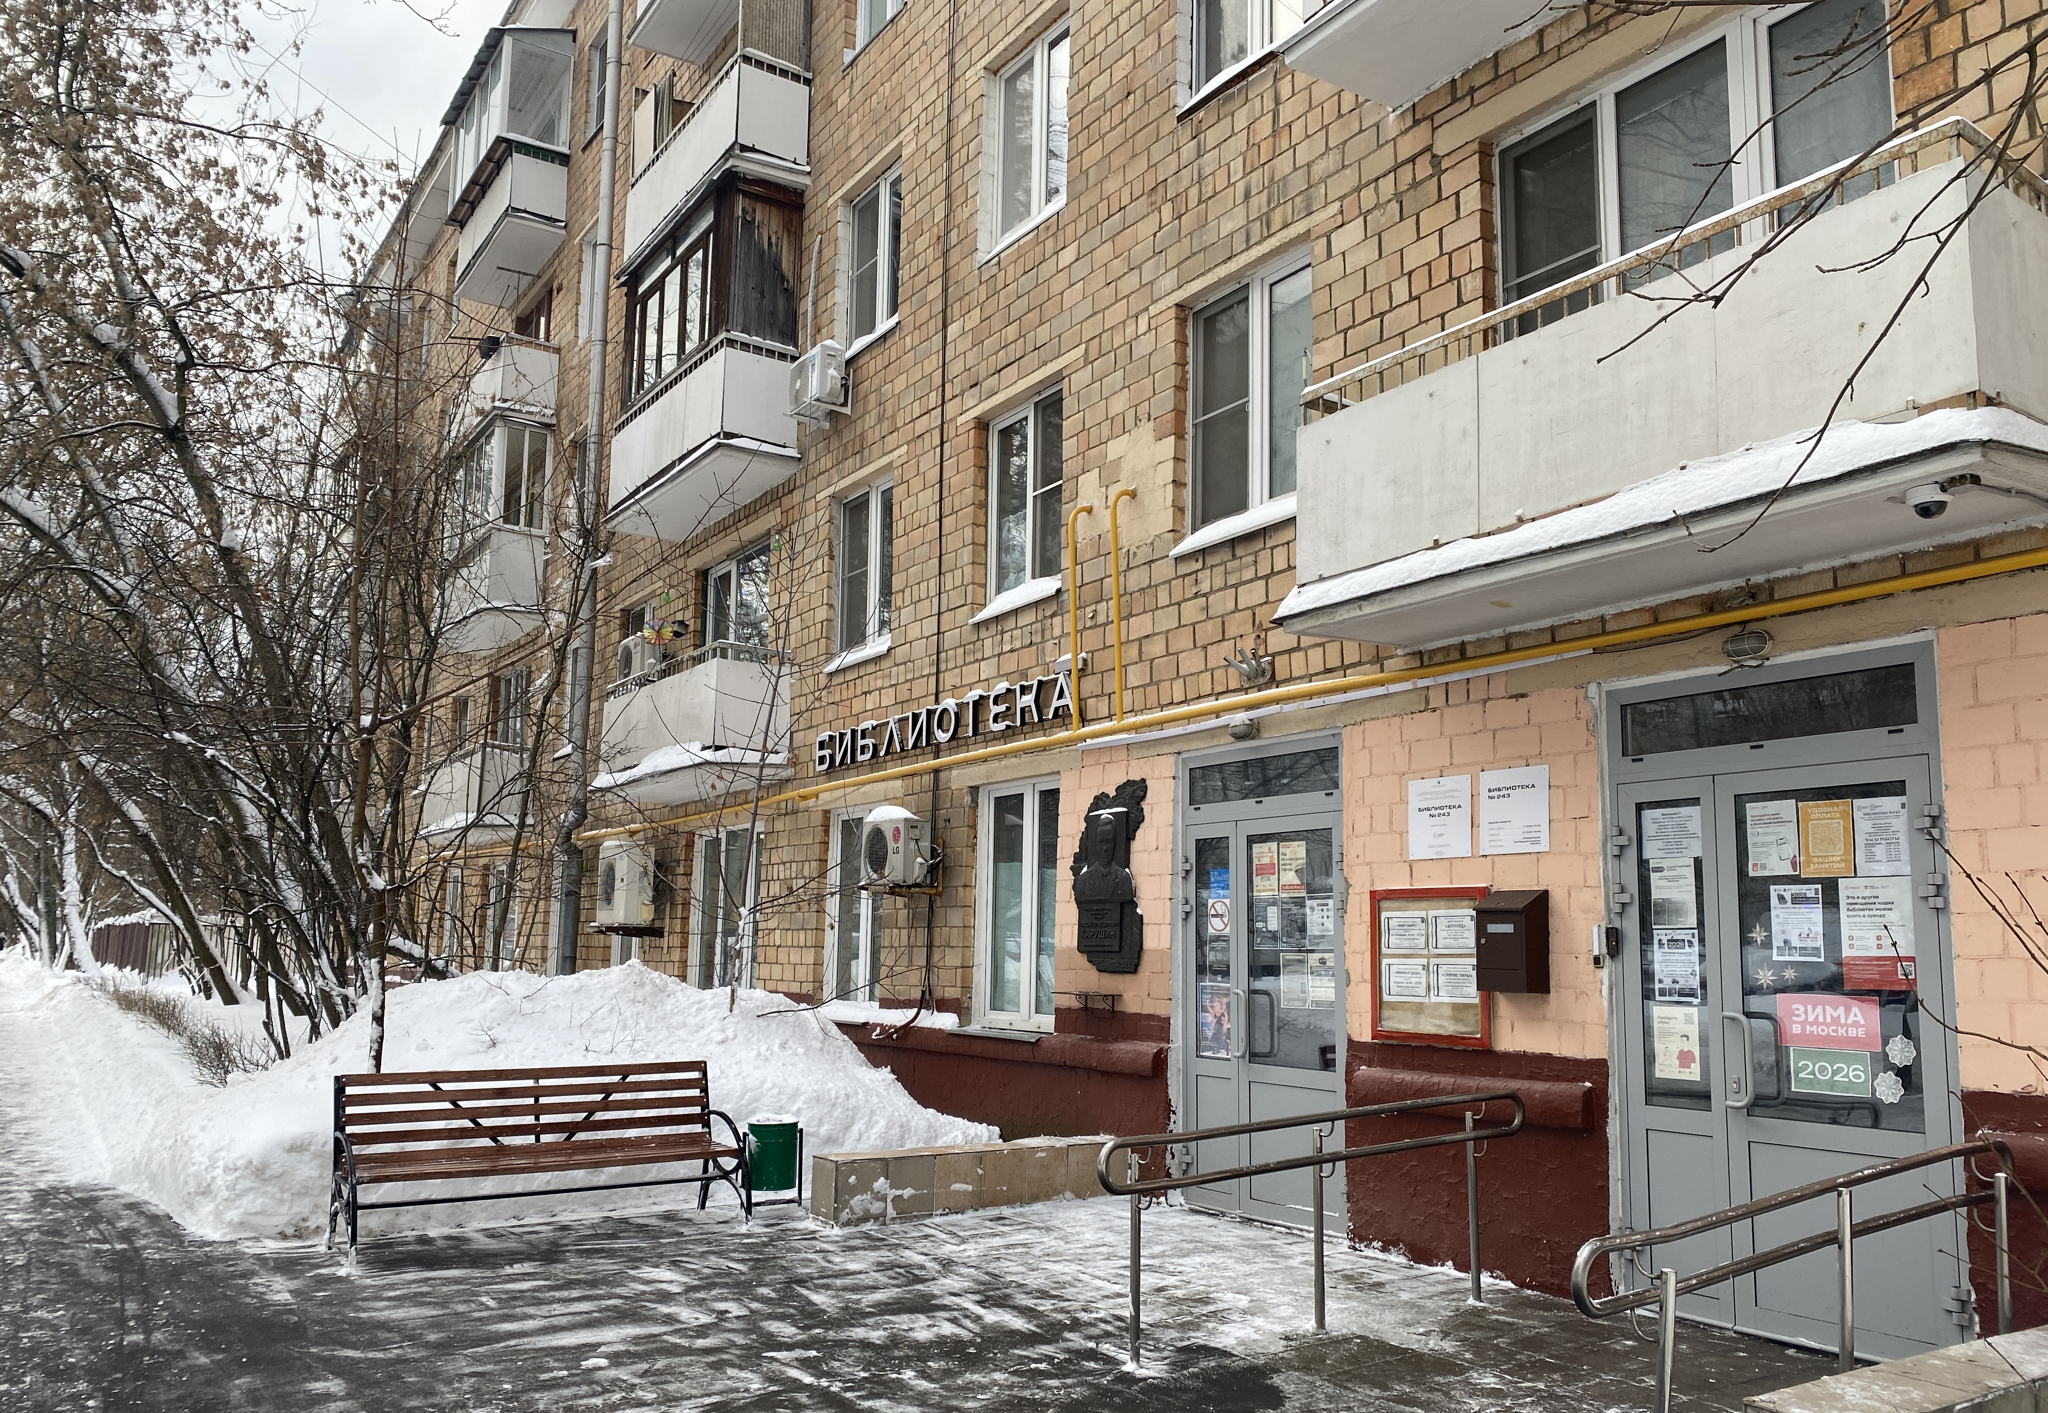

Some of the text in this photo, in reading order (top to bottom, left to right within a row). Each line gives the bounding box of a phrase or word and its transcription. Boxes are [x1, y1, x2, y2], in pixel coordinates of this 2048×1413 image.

[815, 672, 1074, 772] БИБЛИОТЕКА
[1487, 783, 1536, 793] БИБЛИОТЕКА
[1418, 804, 1462, 813] БИБЛИОТЕКА
[892, 846, 900, 855] LG
[1791, 1004, 1866, 1024] ЗИМА
[1792, 1024, 1866, 1038] В МОСКВЕ
[1797, 1060, 1865, 1083] 2026
